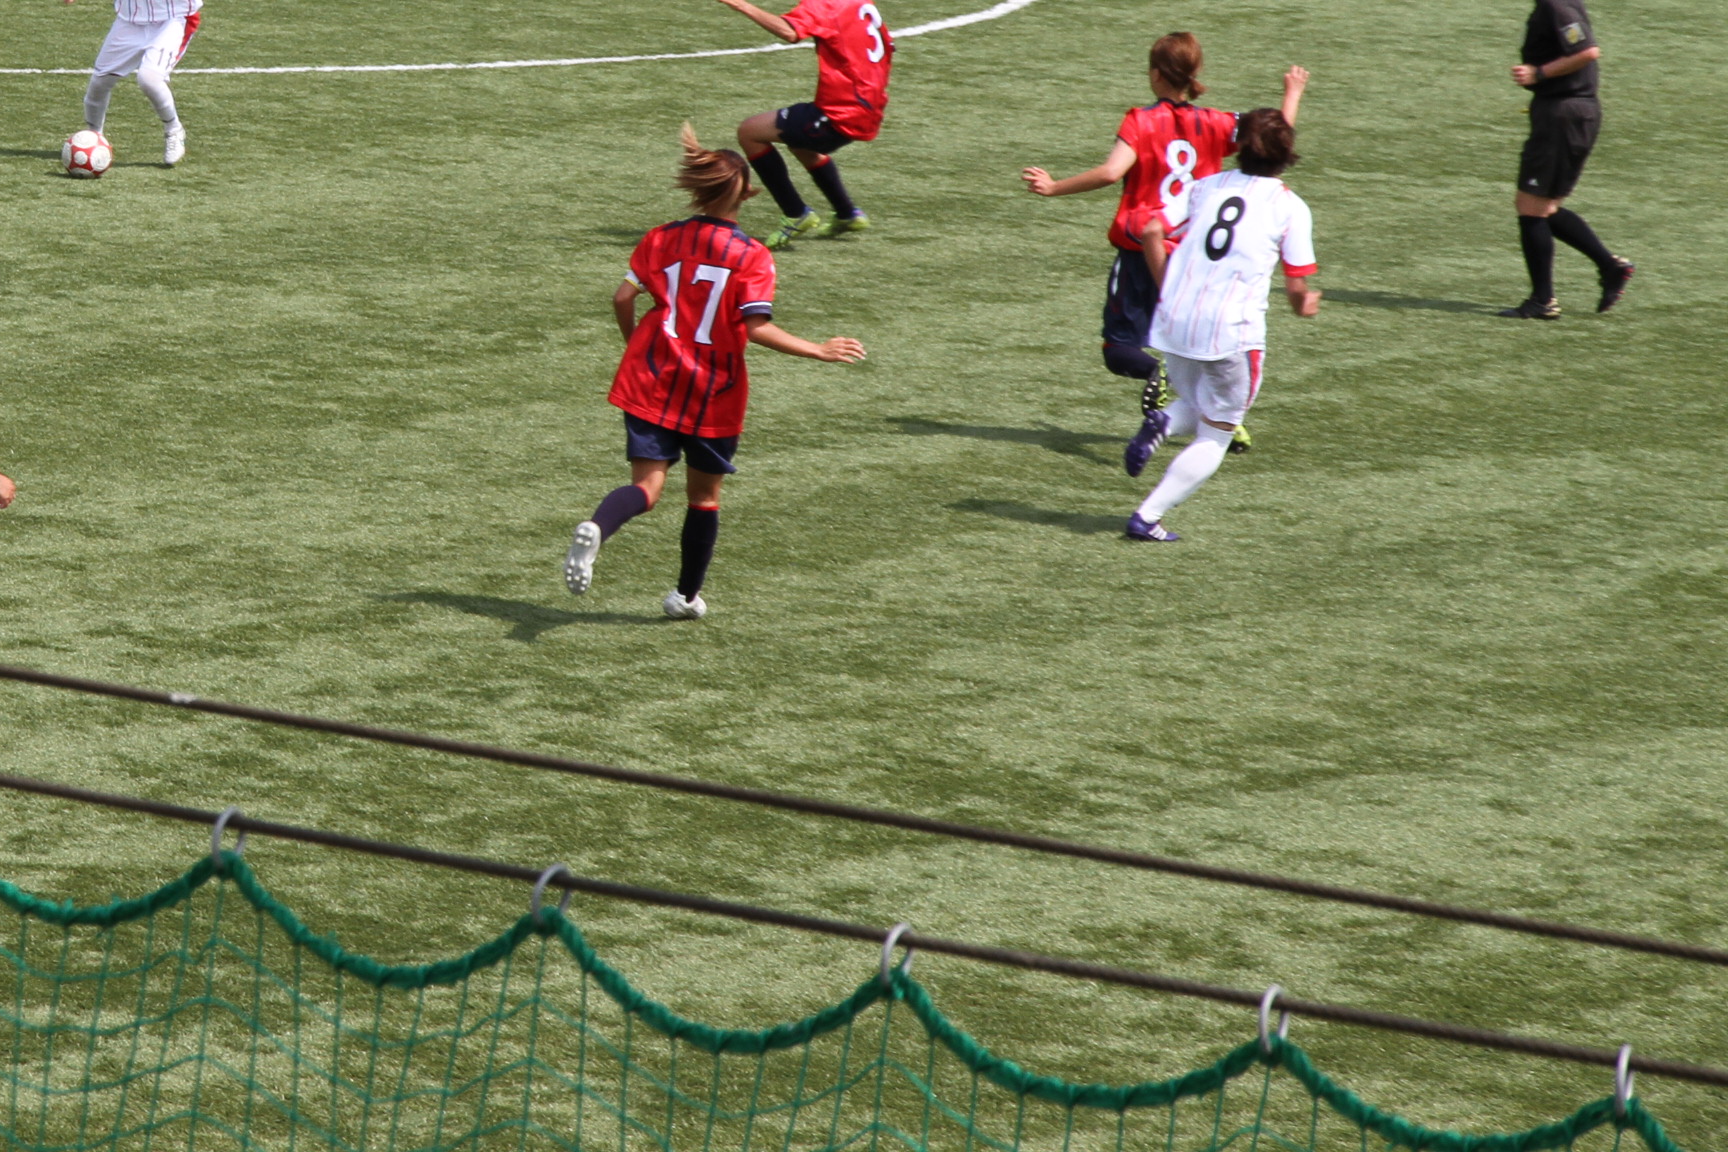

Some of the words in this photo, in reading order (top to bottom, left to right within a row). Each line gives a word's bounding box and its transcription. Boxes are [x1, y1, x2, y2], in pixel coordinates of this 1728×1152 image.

[858, 3, 886, 64] 3
[1159, 138, 1198, 210] 8
[1204, 195, 1246, 262] 8
[662, 260, 732, 346] 17
